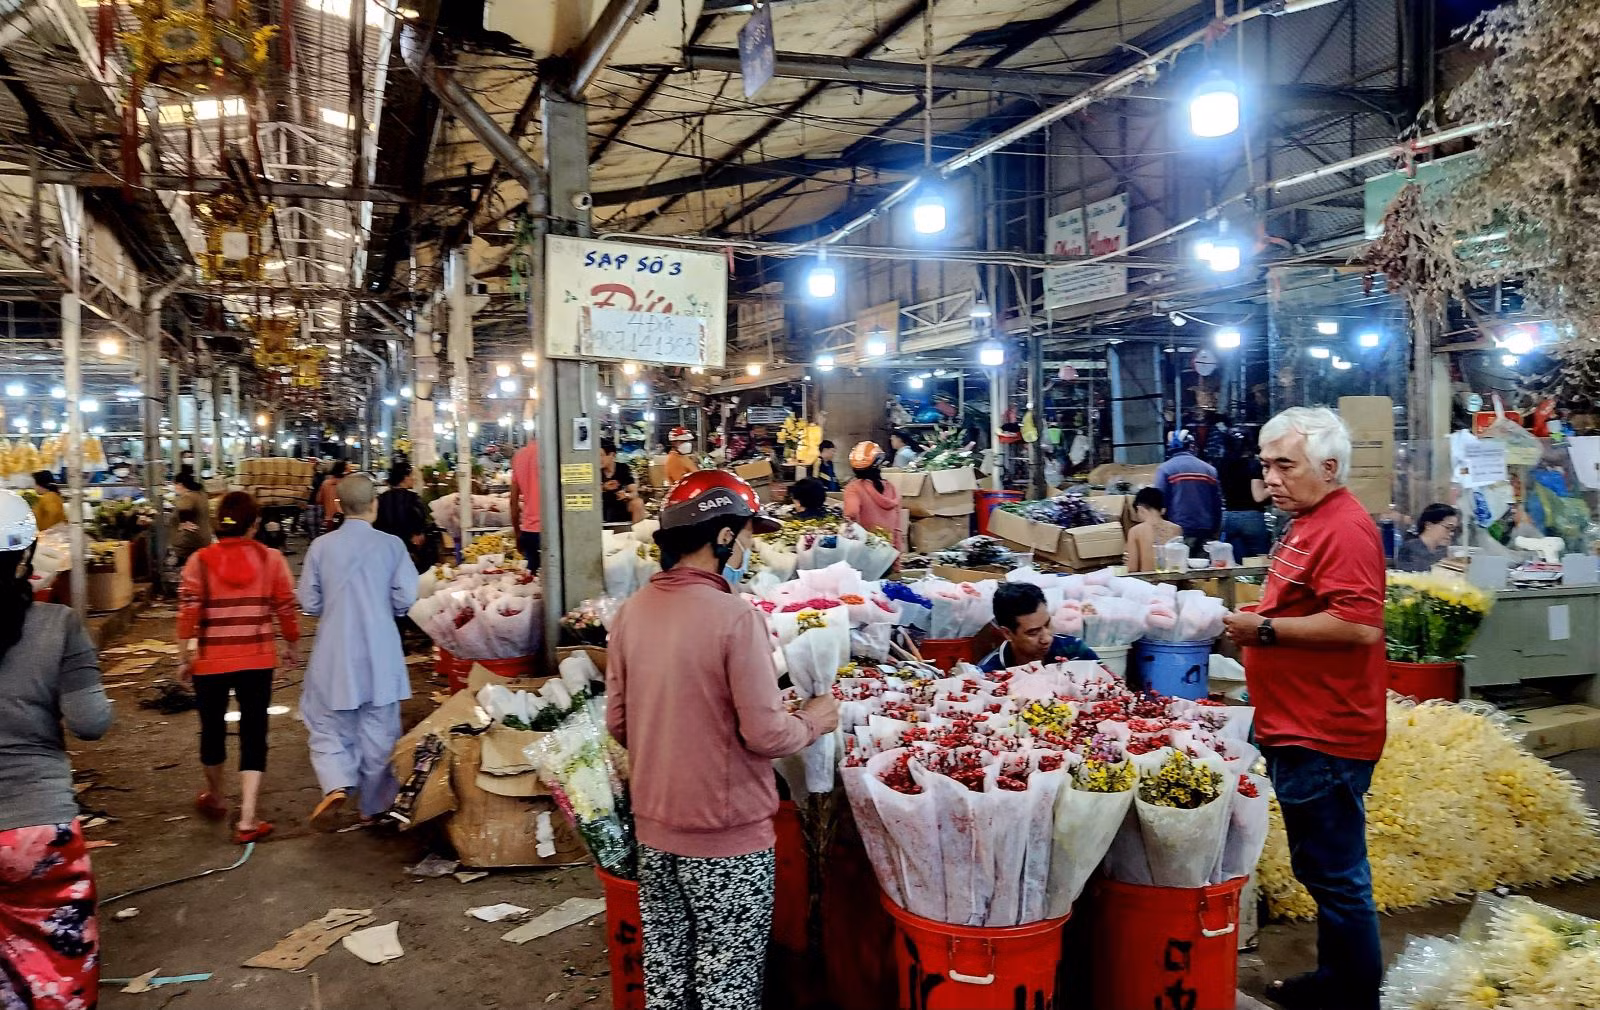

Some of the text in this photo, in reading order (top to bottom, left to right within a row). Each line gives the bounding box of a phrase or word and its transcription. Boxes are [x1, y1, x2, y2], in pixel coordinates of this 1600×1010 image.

[584, 250, 682, 276] SẠP SỐ 3
[698, 496, 733, 512] SAPA
